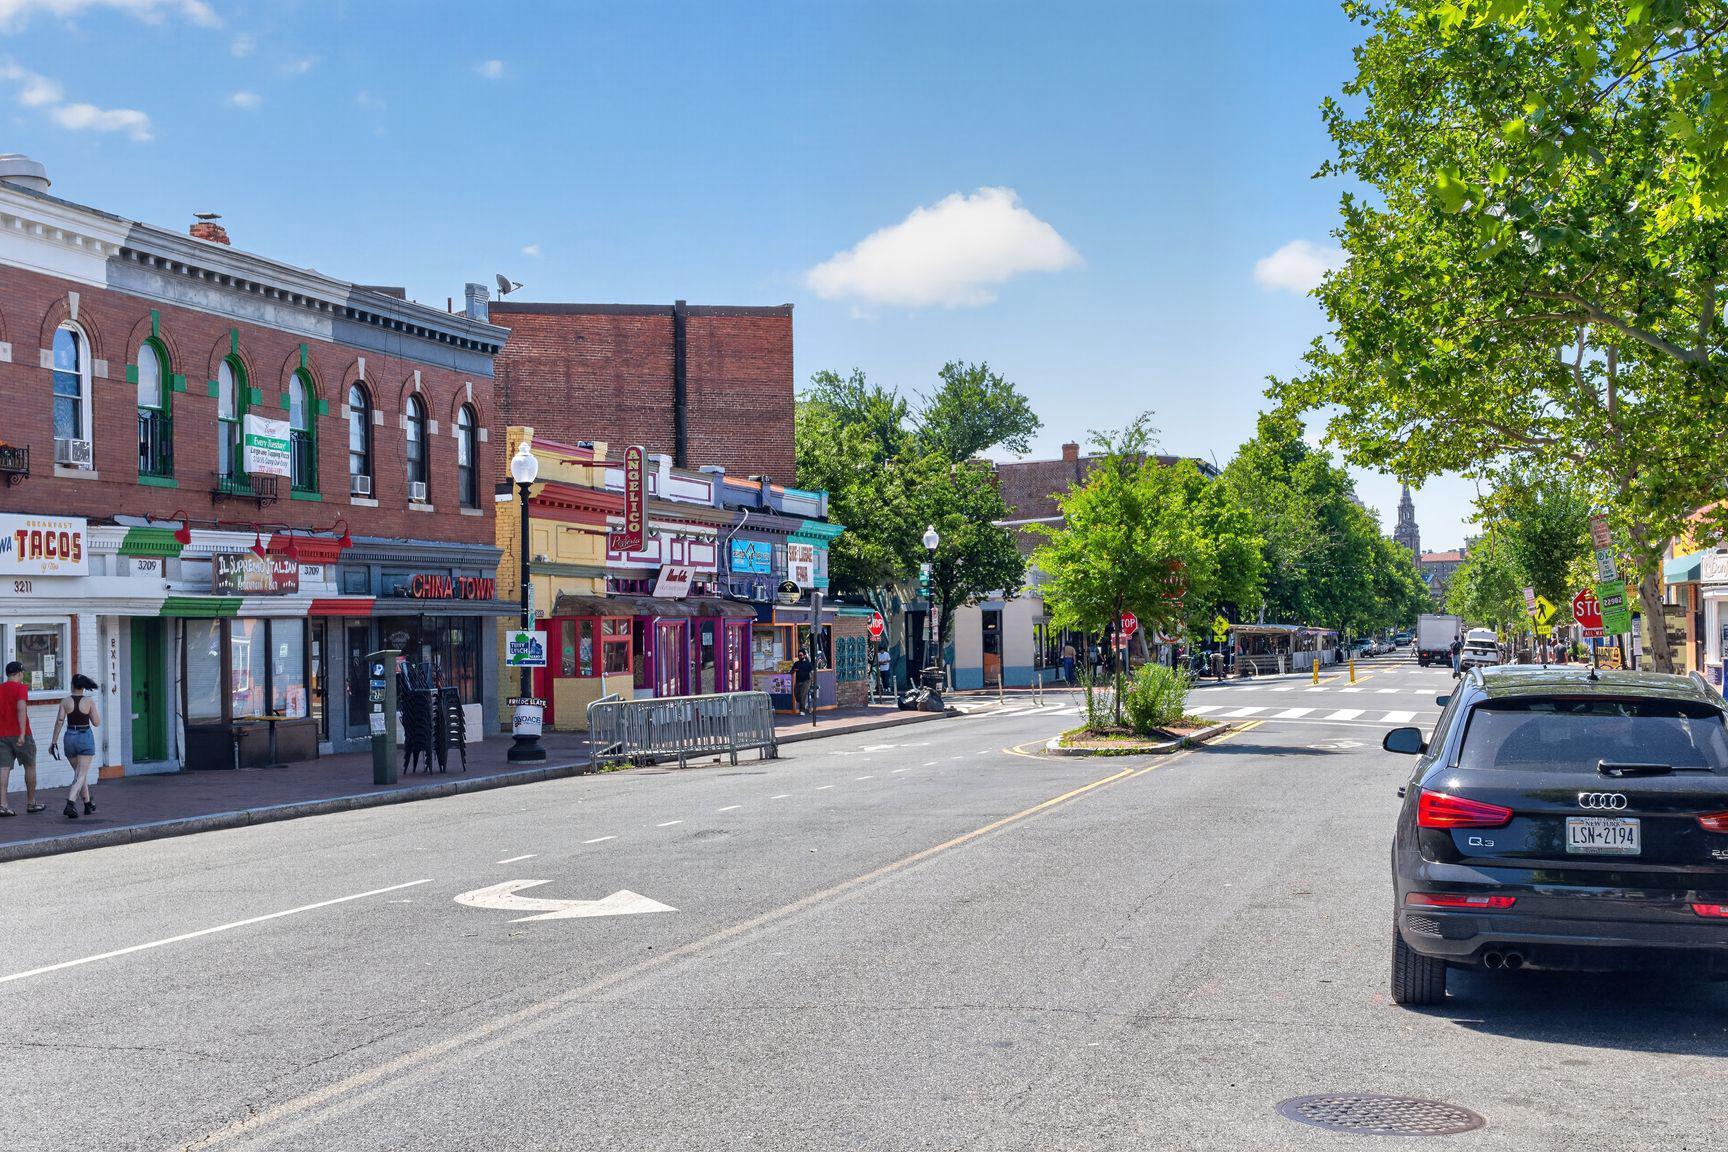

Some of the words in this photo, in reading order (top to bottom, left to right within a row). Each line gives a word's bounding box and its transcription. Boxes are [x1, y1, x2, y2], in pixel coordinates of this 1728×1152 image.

[628, 449, 641, 532] ANGELICO
[26, 520, 73, 528] BREAKFAST
[15, 530, 82, 563] TACOS
[137, 560, 157, 571] 3209
[218, 556, 229, 575] IL
[304, 565, 320, 576] 3209
[14, 580, 33, 593] 3211
[412, 573, 454, 599] CHINA
[459, 575, 497, 600] TOWN
[1576, 600, 1602, 617] STO
